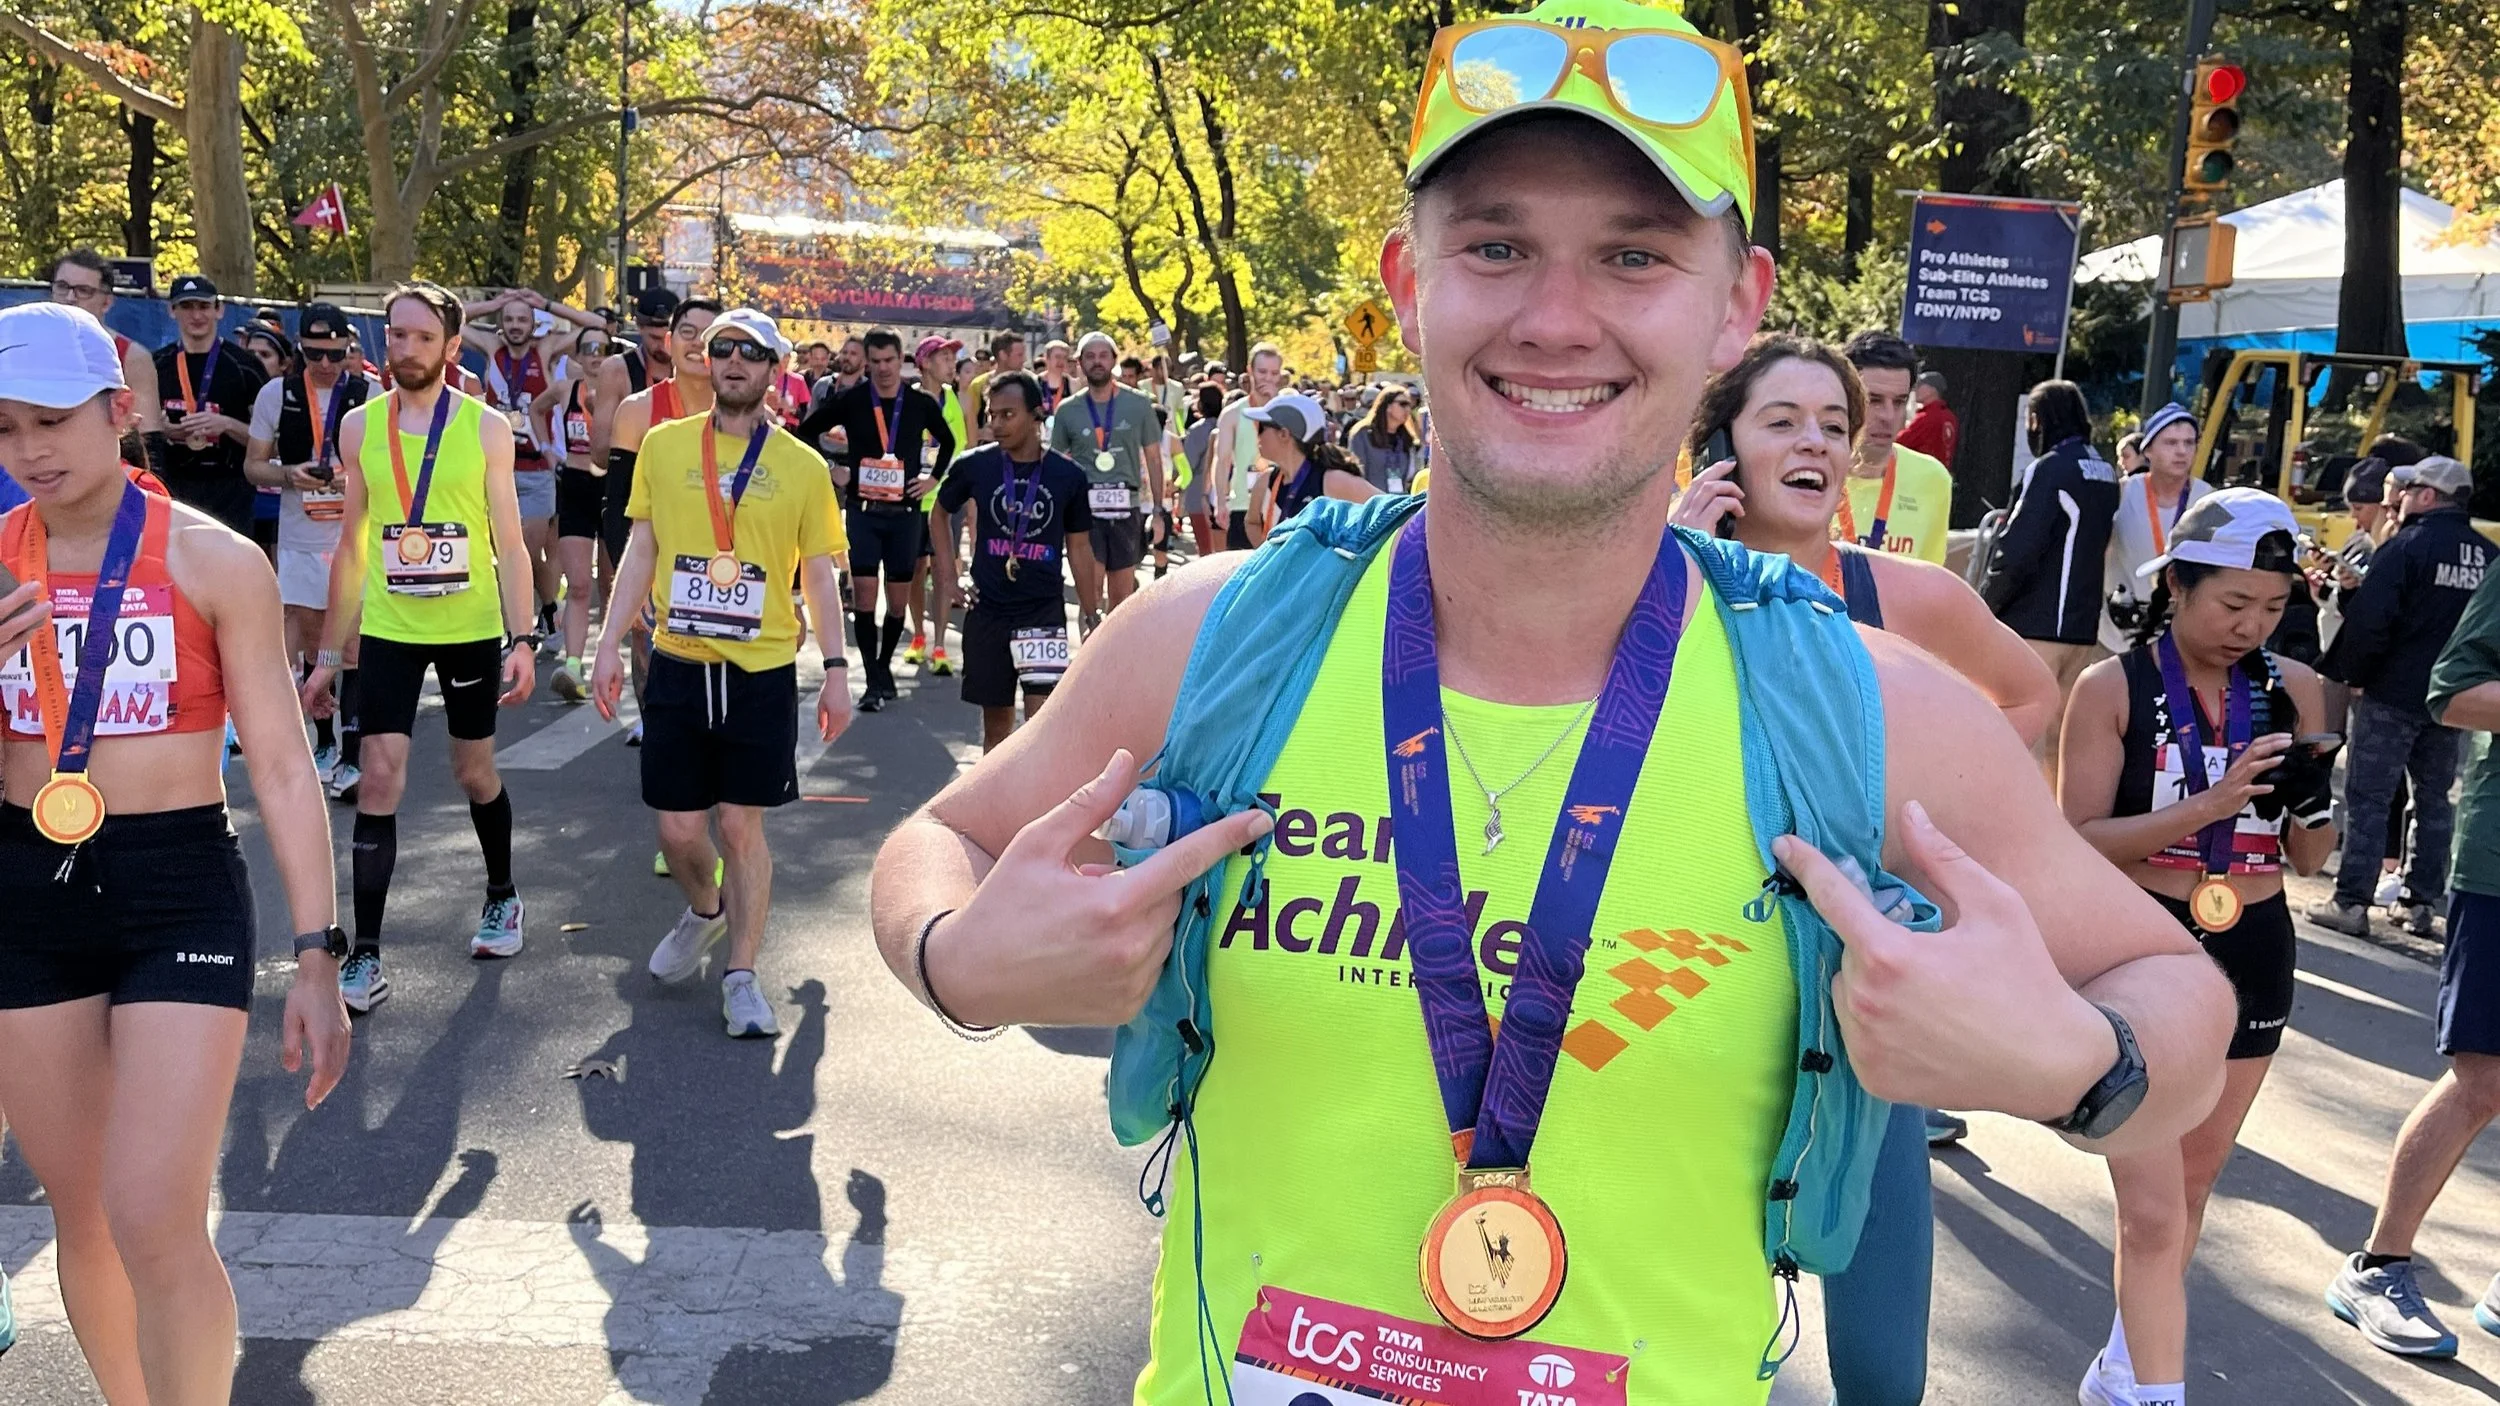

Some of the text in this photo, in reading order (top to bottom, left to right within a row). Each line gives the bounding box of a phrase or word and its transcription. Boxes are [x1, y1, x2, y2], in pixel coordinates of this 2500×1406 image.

[1920, 250, 1946, 264] Pro
[1948, 251, 2009, 269] Athletes
[1918, 268, 2049, 289] Sub-Elite Athletes
[1917, 285, 1991, 302] Team TCS
[1914, 302, 2001, 321] FDNY/NYPD
[866, 469, 898, 483] 4290
[1097, 490, 1125, 503] 6215
[390, 525, 403, 538] tc
[2434, 563, 2485, 590] MARS
[55, 588, 79, 596] TATA
[687, 577, 749, 605] 8199
[120, 602, 149, 612] TATA
[1018, 641, 1068, 660] 12168
[25, 671, 31, 681] 1
[188, 952, 234, 965] BANDIT
[1287, 1305, 1365, 1371] tcs
[1376, 1325, 1424, 1352] TATA
[1372, 1345, 1489, 1383] CONSULTANCY
[1368, 1363, 1443, 1393] SERVICES
[1517, 1388, 1577, 1406] TATA
